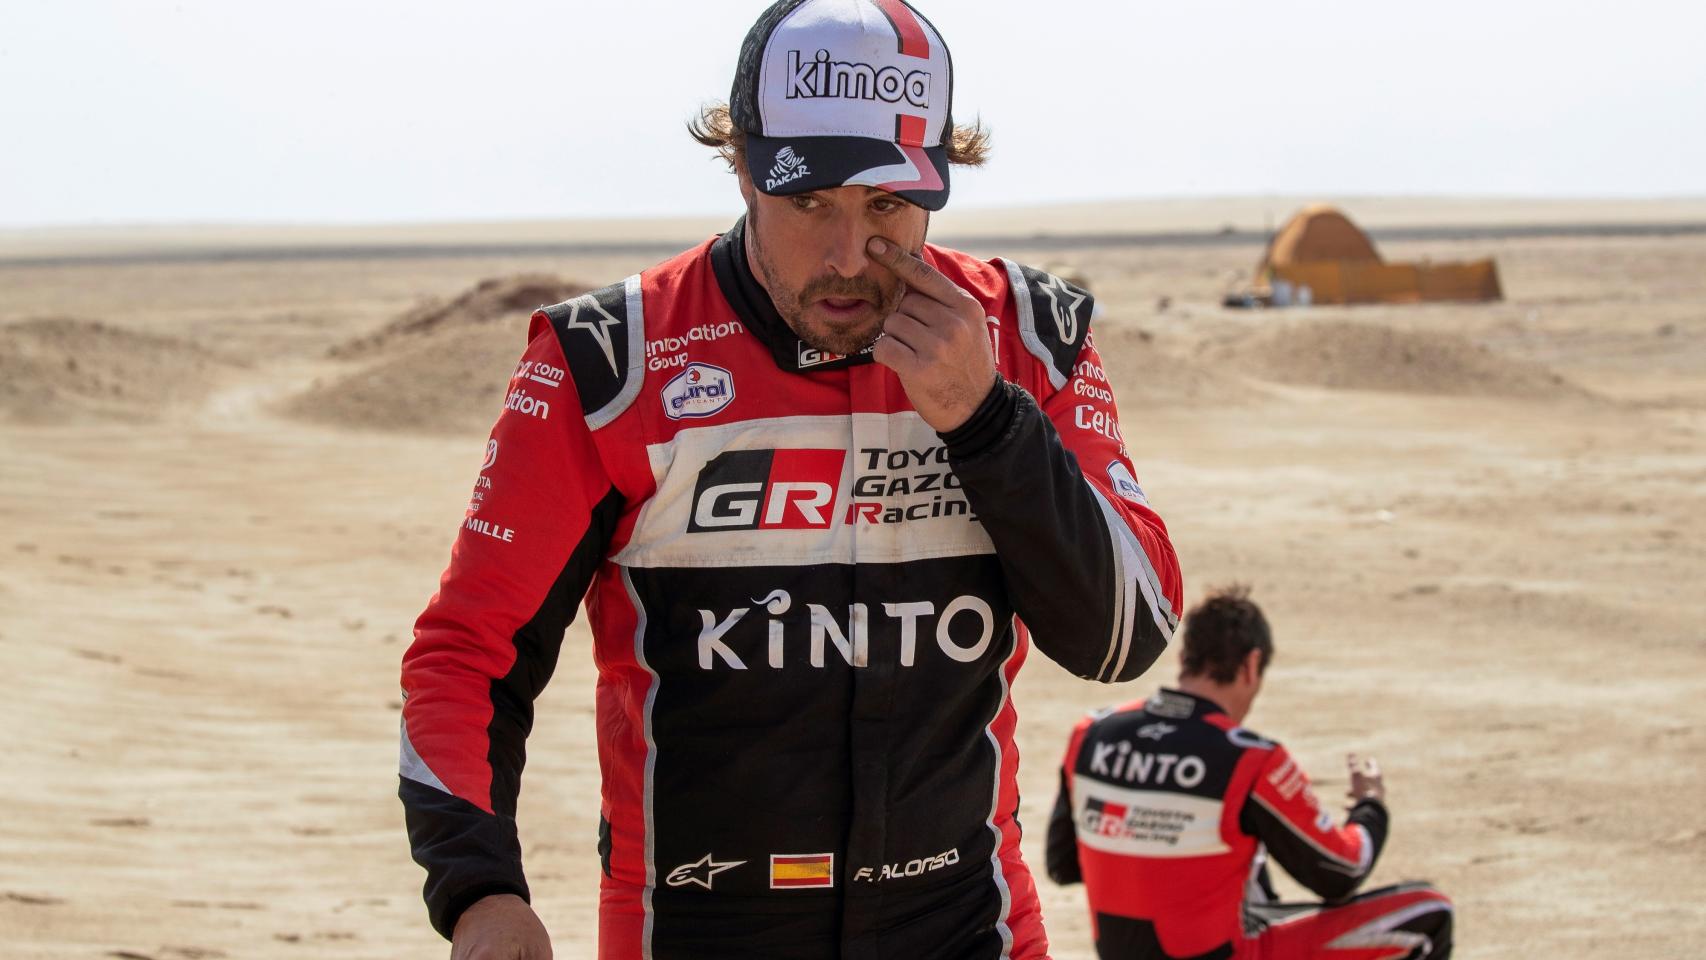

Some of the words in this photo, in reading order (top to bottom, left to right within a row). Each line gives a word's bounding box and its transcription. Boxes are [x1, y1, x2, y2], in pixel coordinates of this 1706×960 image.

[786, 49, 931, 109] kimoa
[765, 165, 811, 191] DAKAR
[694, 481, 833, 528] GR
[466, 516, 515, 543] MILLE
[853, 867, 873, 882] F.
